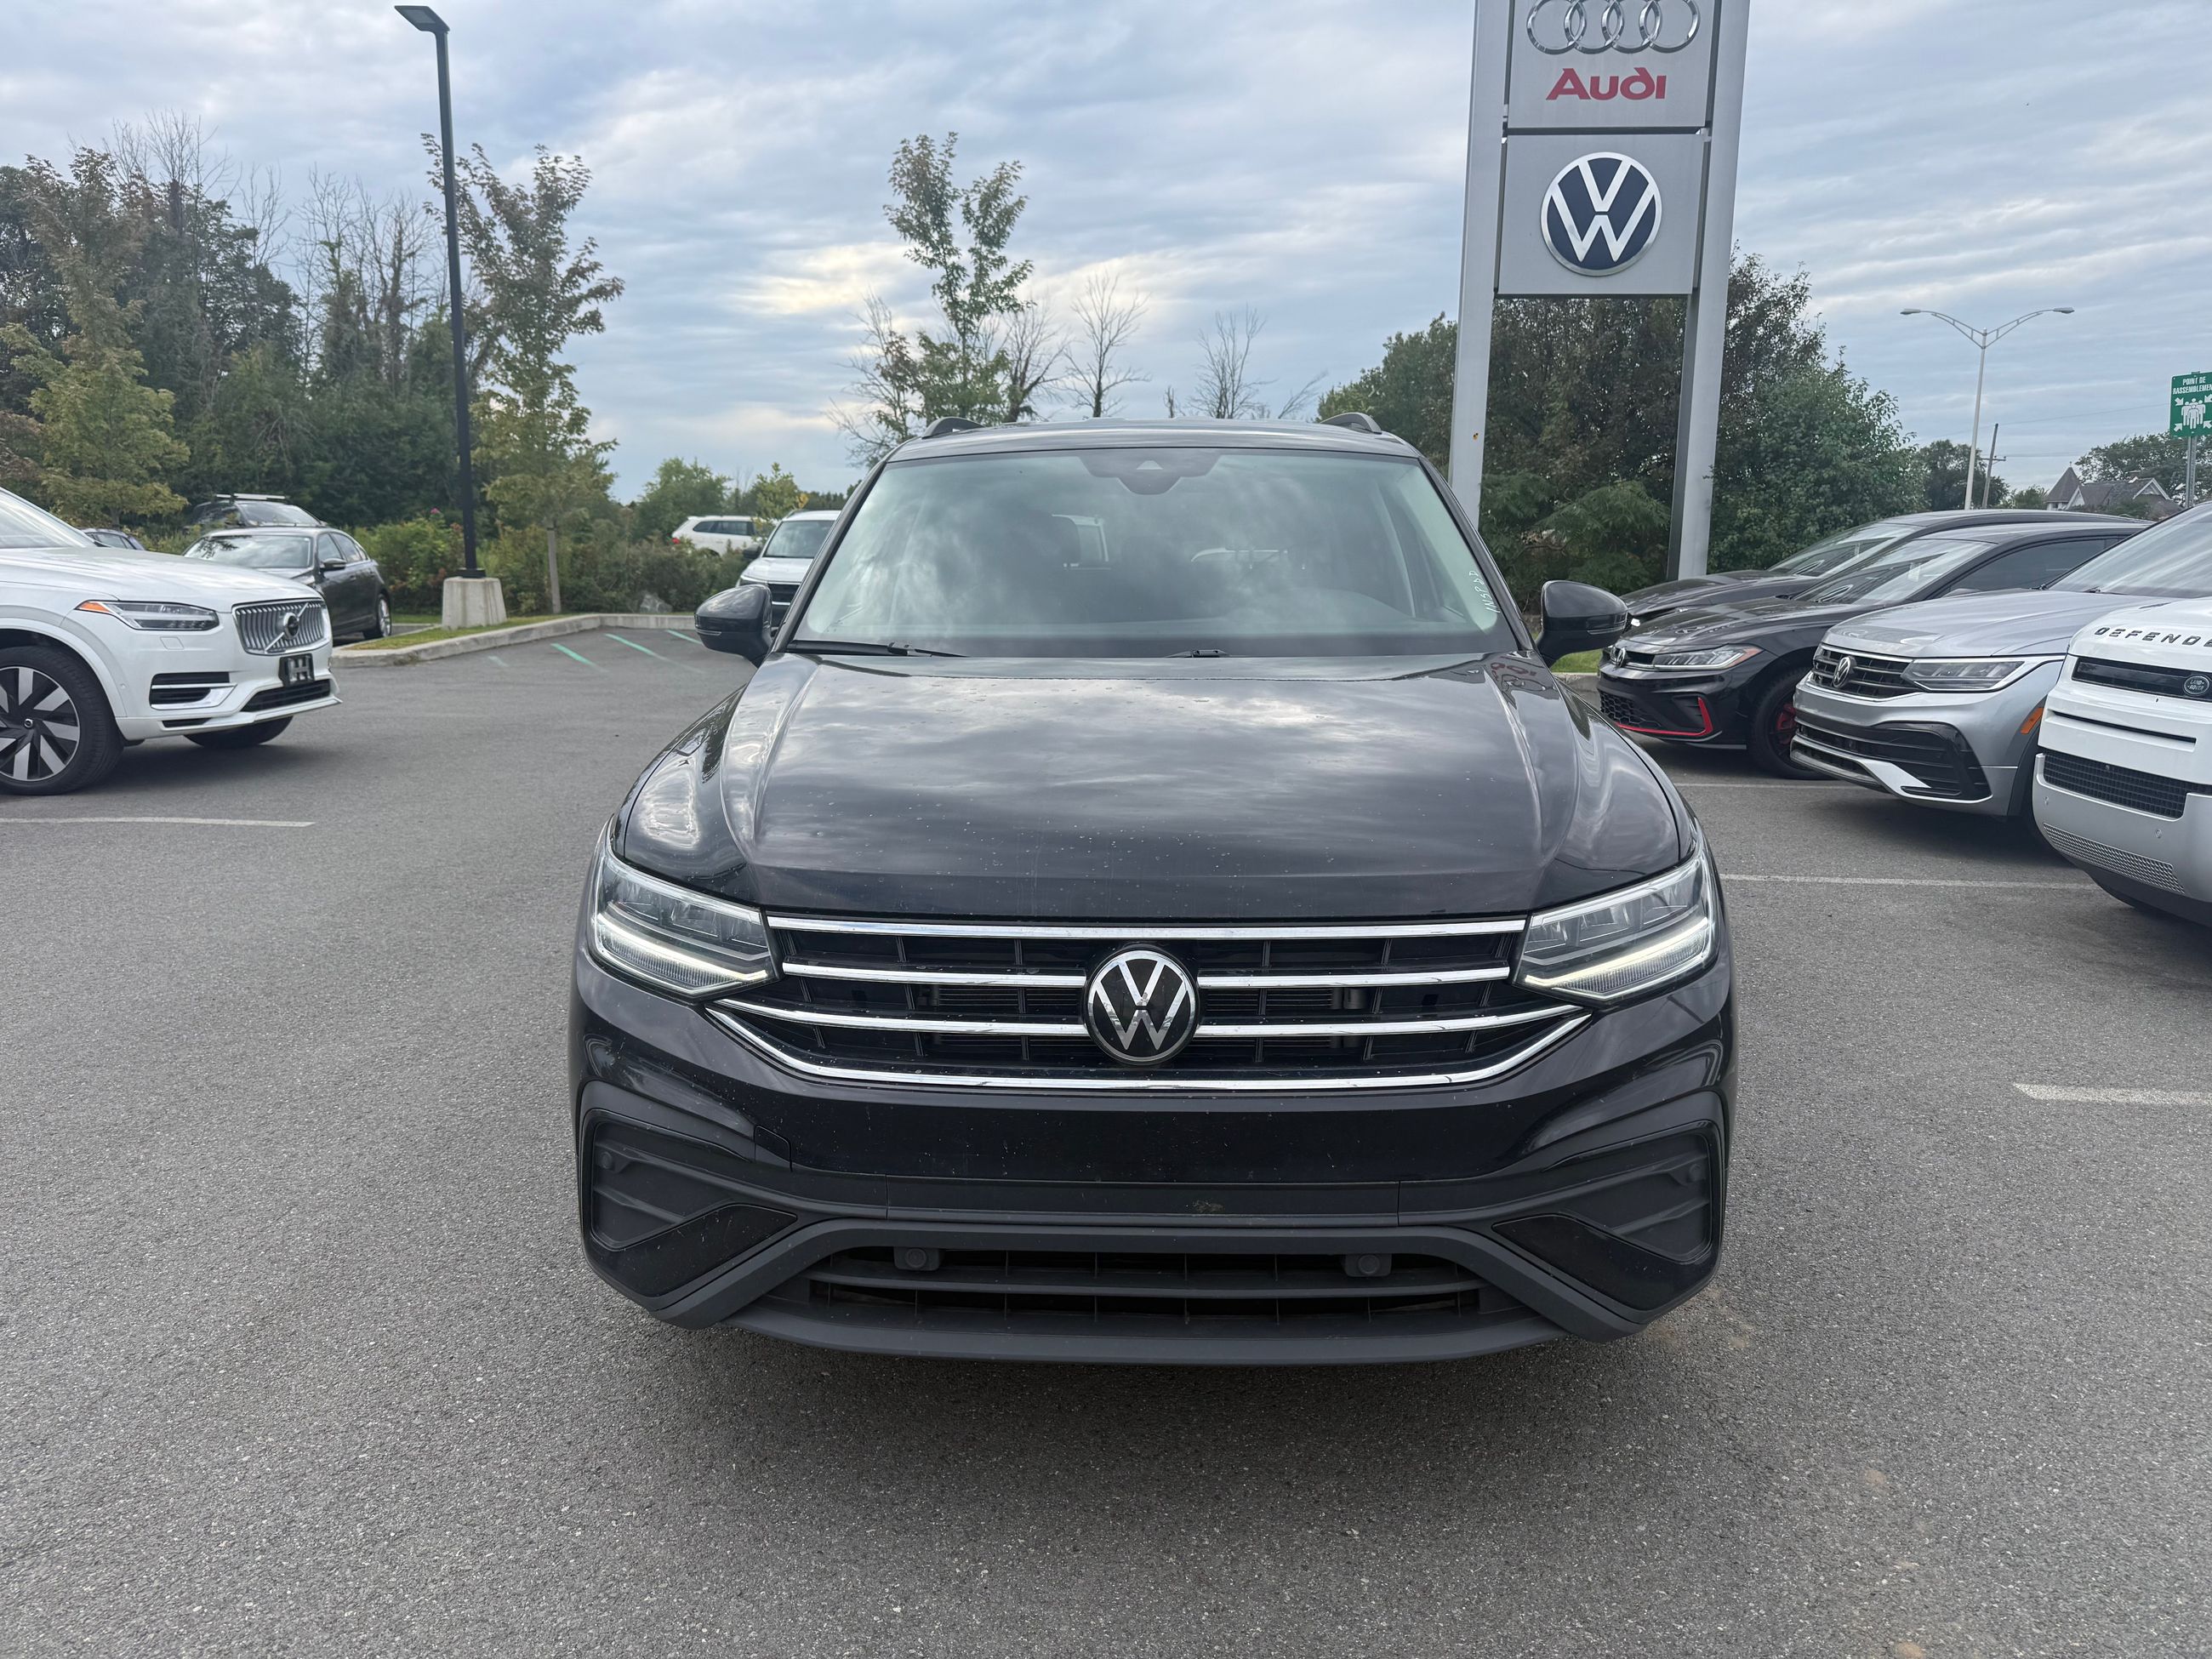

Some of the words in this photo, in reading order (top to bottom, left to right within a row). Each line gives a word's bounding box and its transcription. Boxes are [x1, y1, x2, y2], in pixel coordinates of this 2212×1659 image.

[1545, 67, 1667, 100] Audi
[1547, 154, 1658, 264] VW
[2182, 377, 2198, 385] POINT
[1090, 951, 1194, 1053] VW
